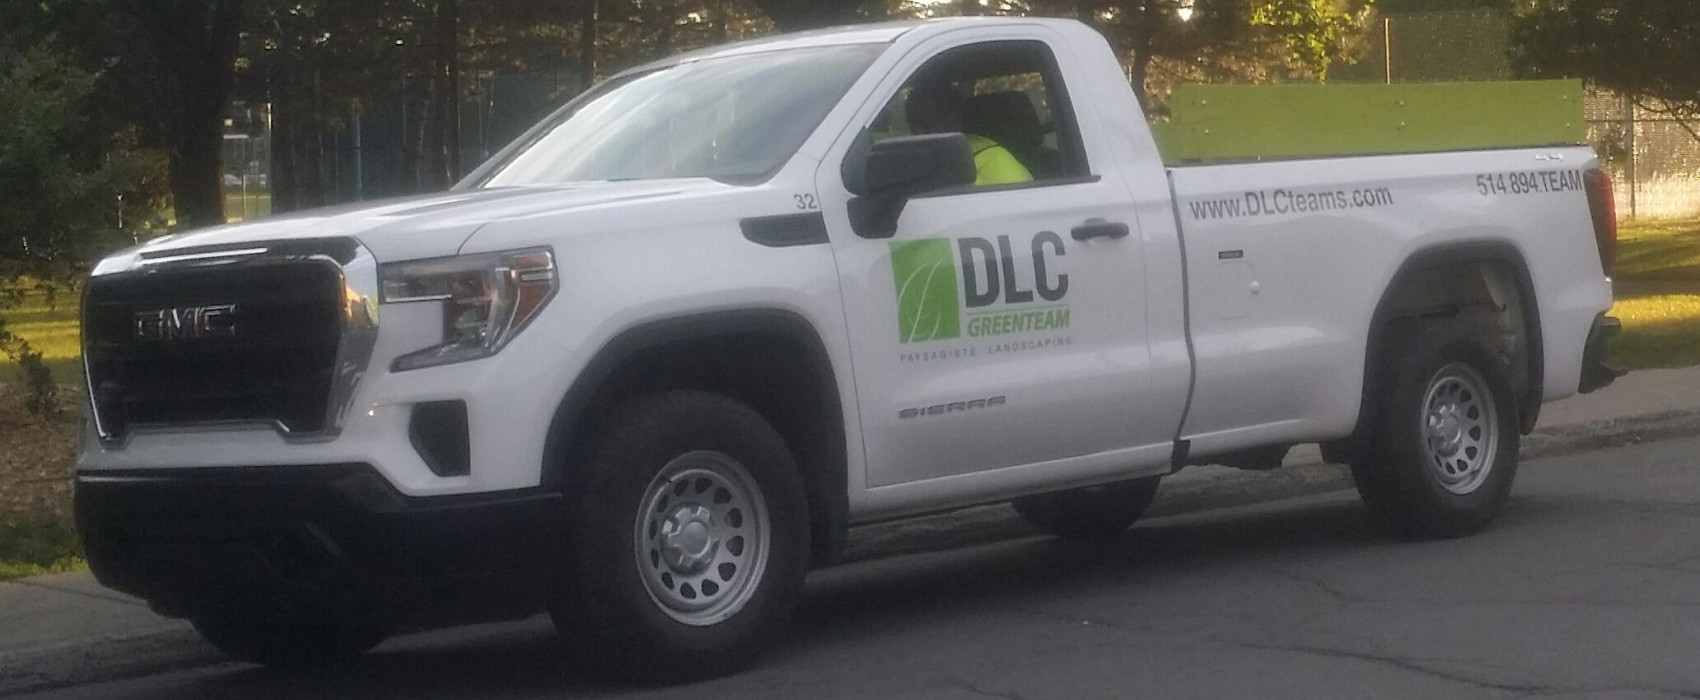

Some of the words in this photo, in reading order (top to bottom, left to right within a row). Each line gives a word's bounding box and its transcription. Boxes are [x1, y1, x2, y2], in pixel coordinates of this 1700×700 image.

[794, 193, 817, 209] 32
[1189, 187, 1393, 220] www.DLCteams.com
[957, 231, 1069, 308] DLC
[135, 304, 235, 341] GMC
[967, 308, 1071, 338] GREENTEAM
[900, 347, 976, 362] PAYSAGISTE
[988, 337, 1073, 354] LANDSCAPING
[898, 396, 1006, 419] SIERRA
